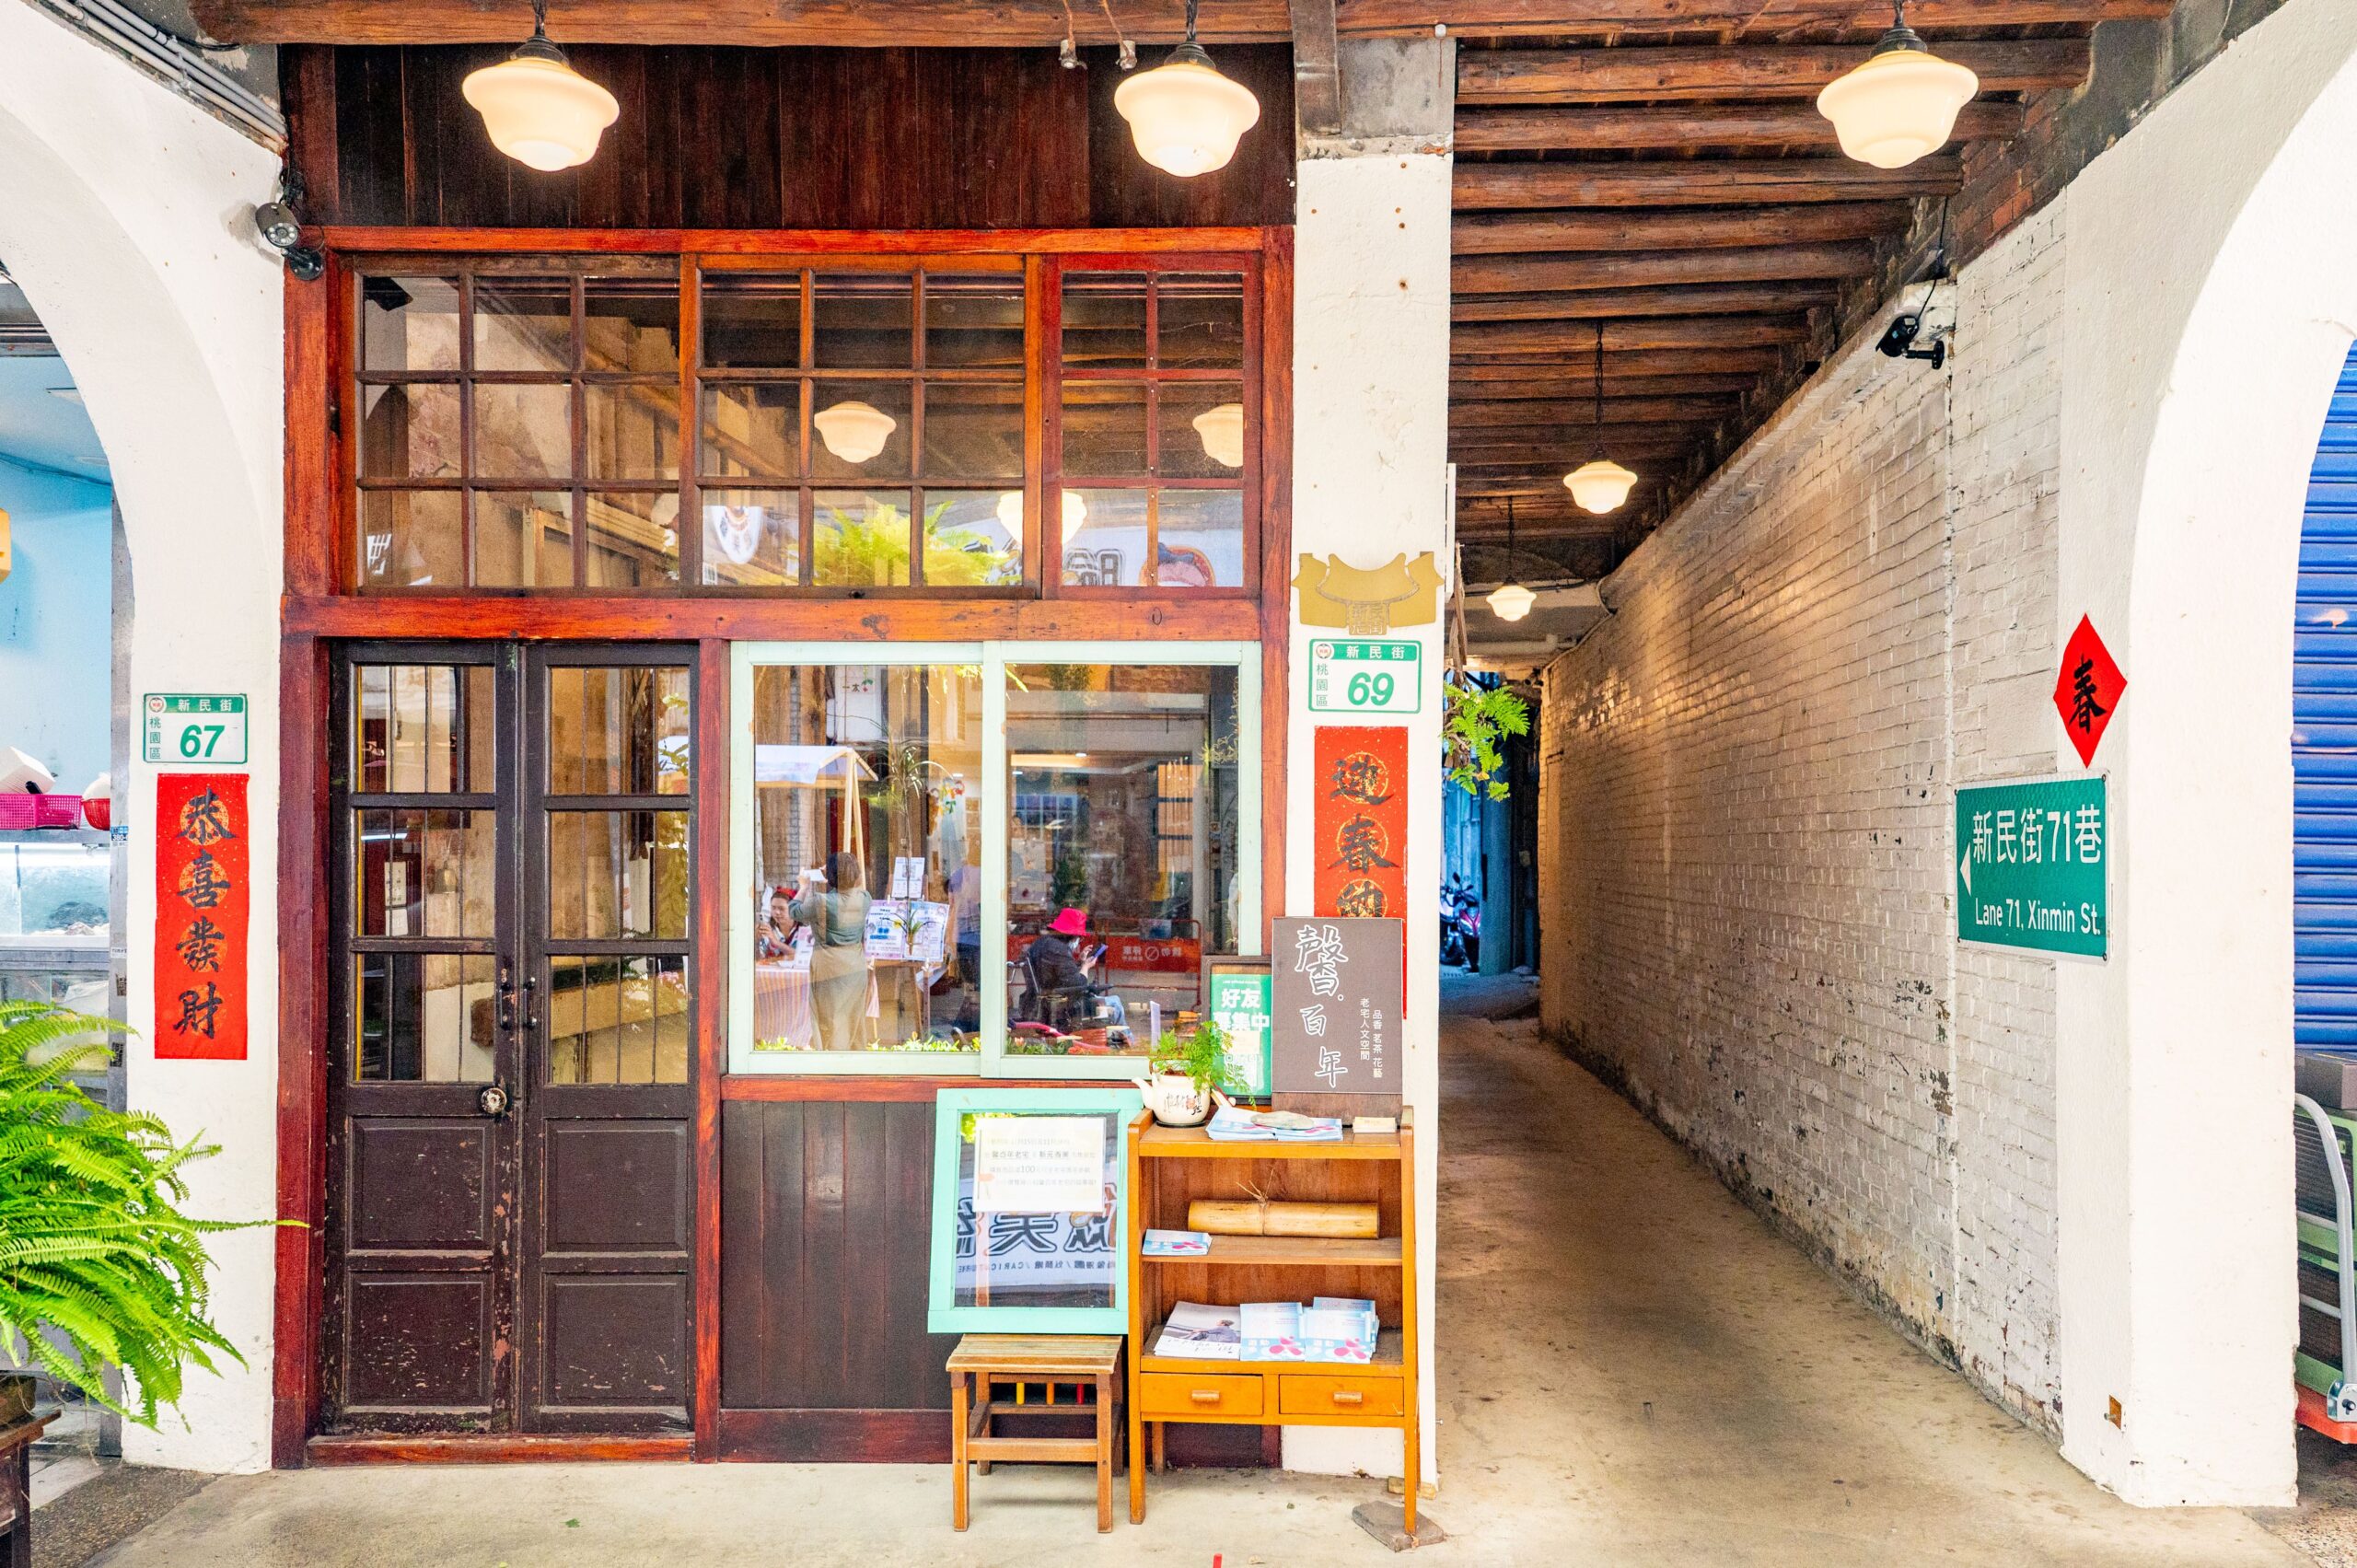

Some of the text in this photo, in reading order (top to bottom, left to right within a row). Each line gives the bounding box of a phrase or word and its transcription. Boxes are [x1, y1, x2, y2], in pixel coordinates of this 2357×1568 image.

[1346, 645, 1405, 659] 新民街
[1316, 663, 1329, 706] 桃園區
[1347, 672, 1395, 706] 69
[2068, 653, 2107, 735] 春
[179, 699, 233, 712] 新民街
[149, 716, 161, 759] 桃園區
[180, 725, 226, 758] 67
[1972, 803, 2102, 864] 新民街71巷
[174, 788, 239, 1040] 恭喜發財
[1975, 897, 2101, 935] Lane 71, Xinmin St.
[1221, 988, 1262, 1009] 好友
[1359, 997, 1370, 1061] 老宅人文空間
